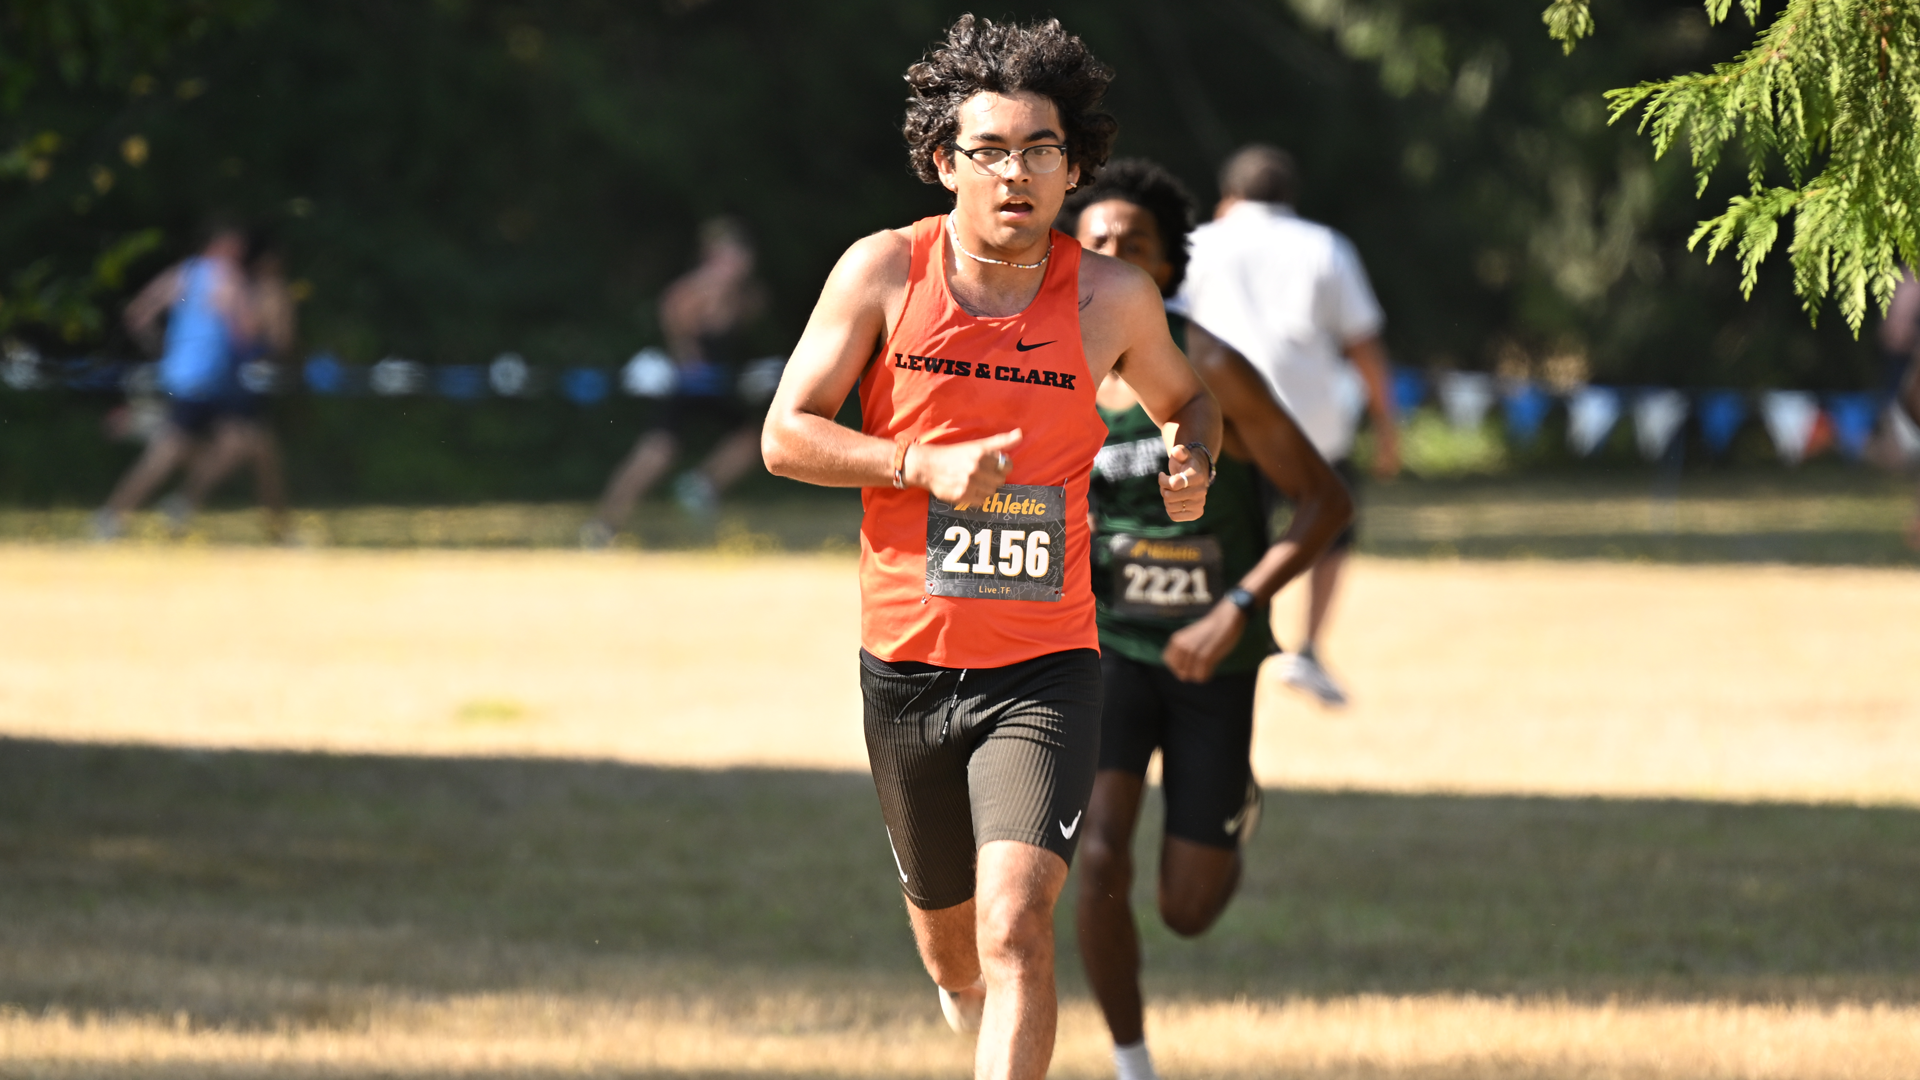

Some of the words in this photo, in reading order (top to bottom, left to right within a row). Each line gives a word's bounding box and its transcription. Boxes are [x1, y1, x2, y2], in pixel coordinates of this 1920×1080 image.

[895, 353, 971, 377] LEWIS
[975, 363, 991, 379] &
[995, 366, 1076, 390] CLARK
[942, 526, 1051, 578] 2156
[979, 586, 1011, 595] Live.TF
[1123, 563, 1213, 605] 2221
